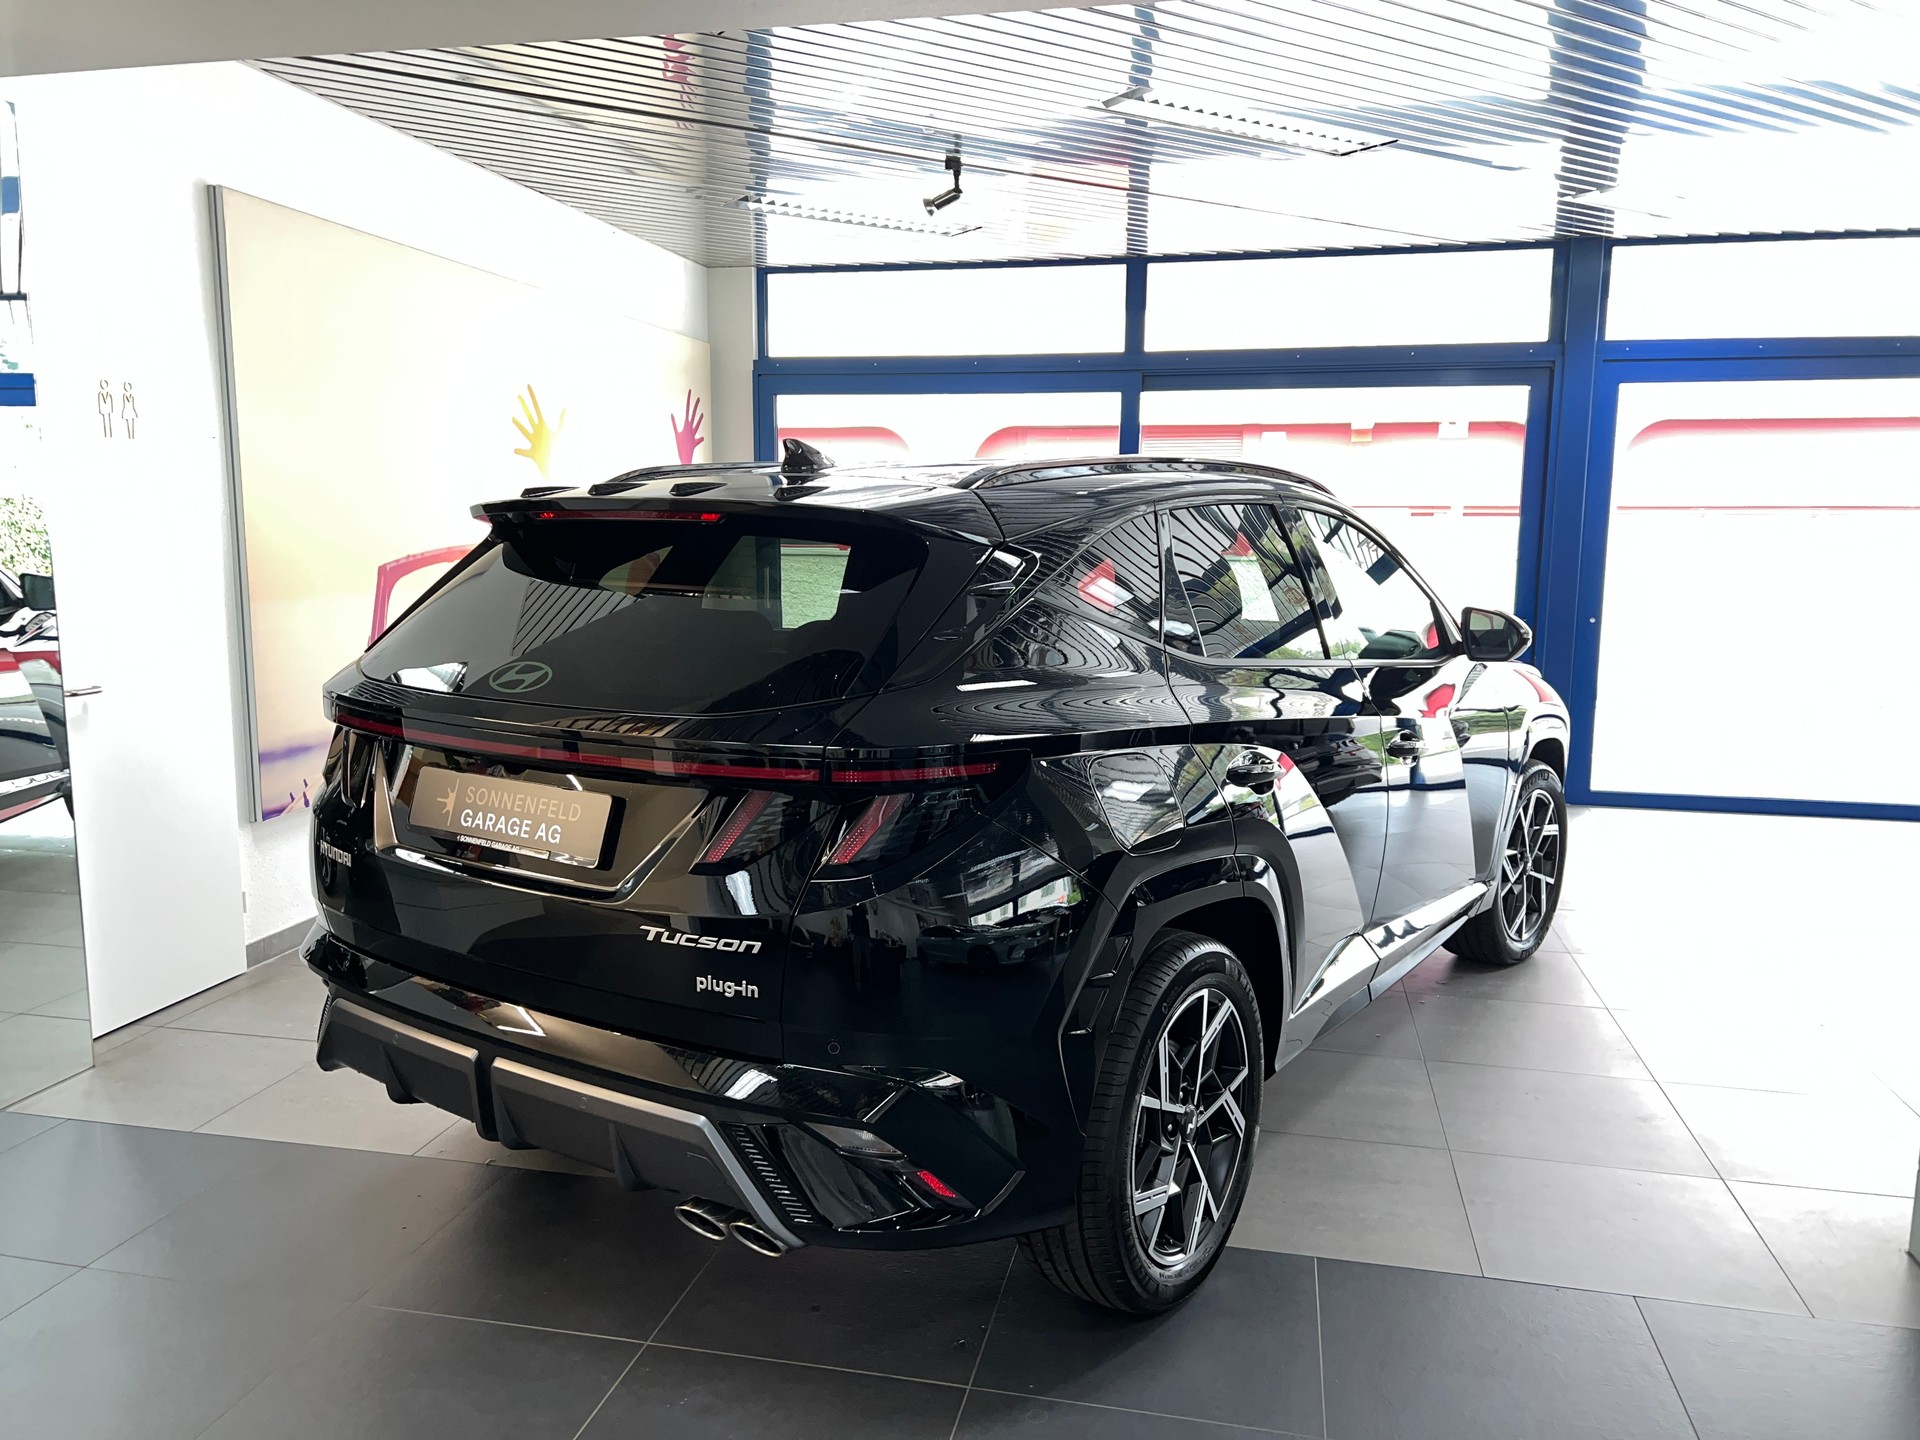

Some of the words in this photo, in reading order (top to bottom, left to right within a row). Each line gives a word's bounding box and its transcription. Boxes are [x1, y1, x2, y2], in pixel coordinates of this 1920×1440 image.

[465, 785, 582, 822] SONNENFELD
[460, 808, 532, 839] GARAGE
[534, 822, 562, 844] AG
[460, 834, 491, 847] SONNENFELD
[320, 839, 352, 868] HYUNDAI
[695, 974, 759, 998] plug-in
